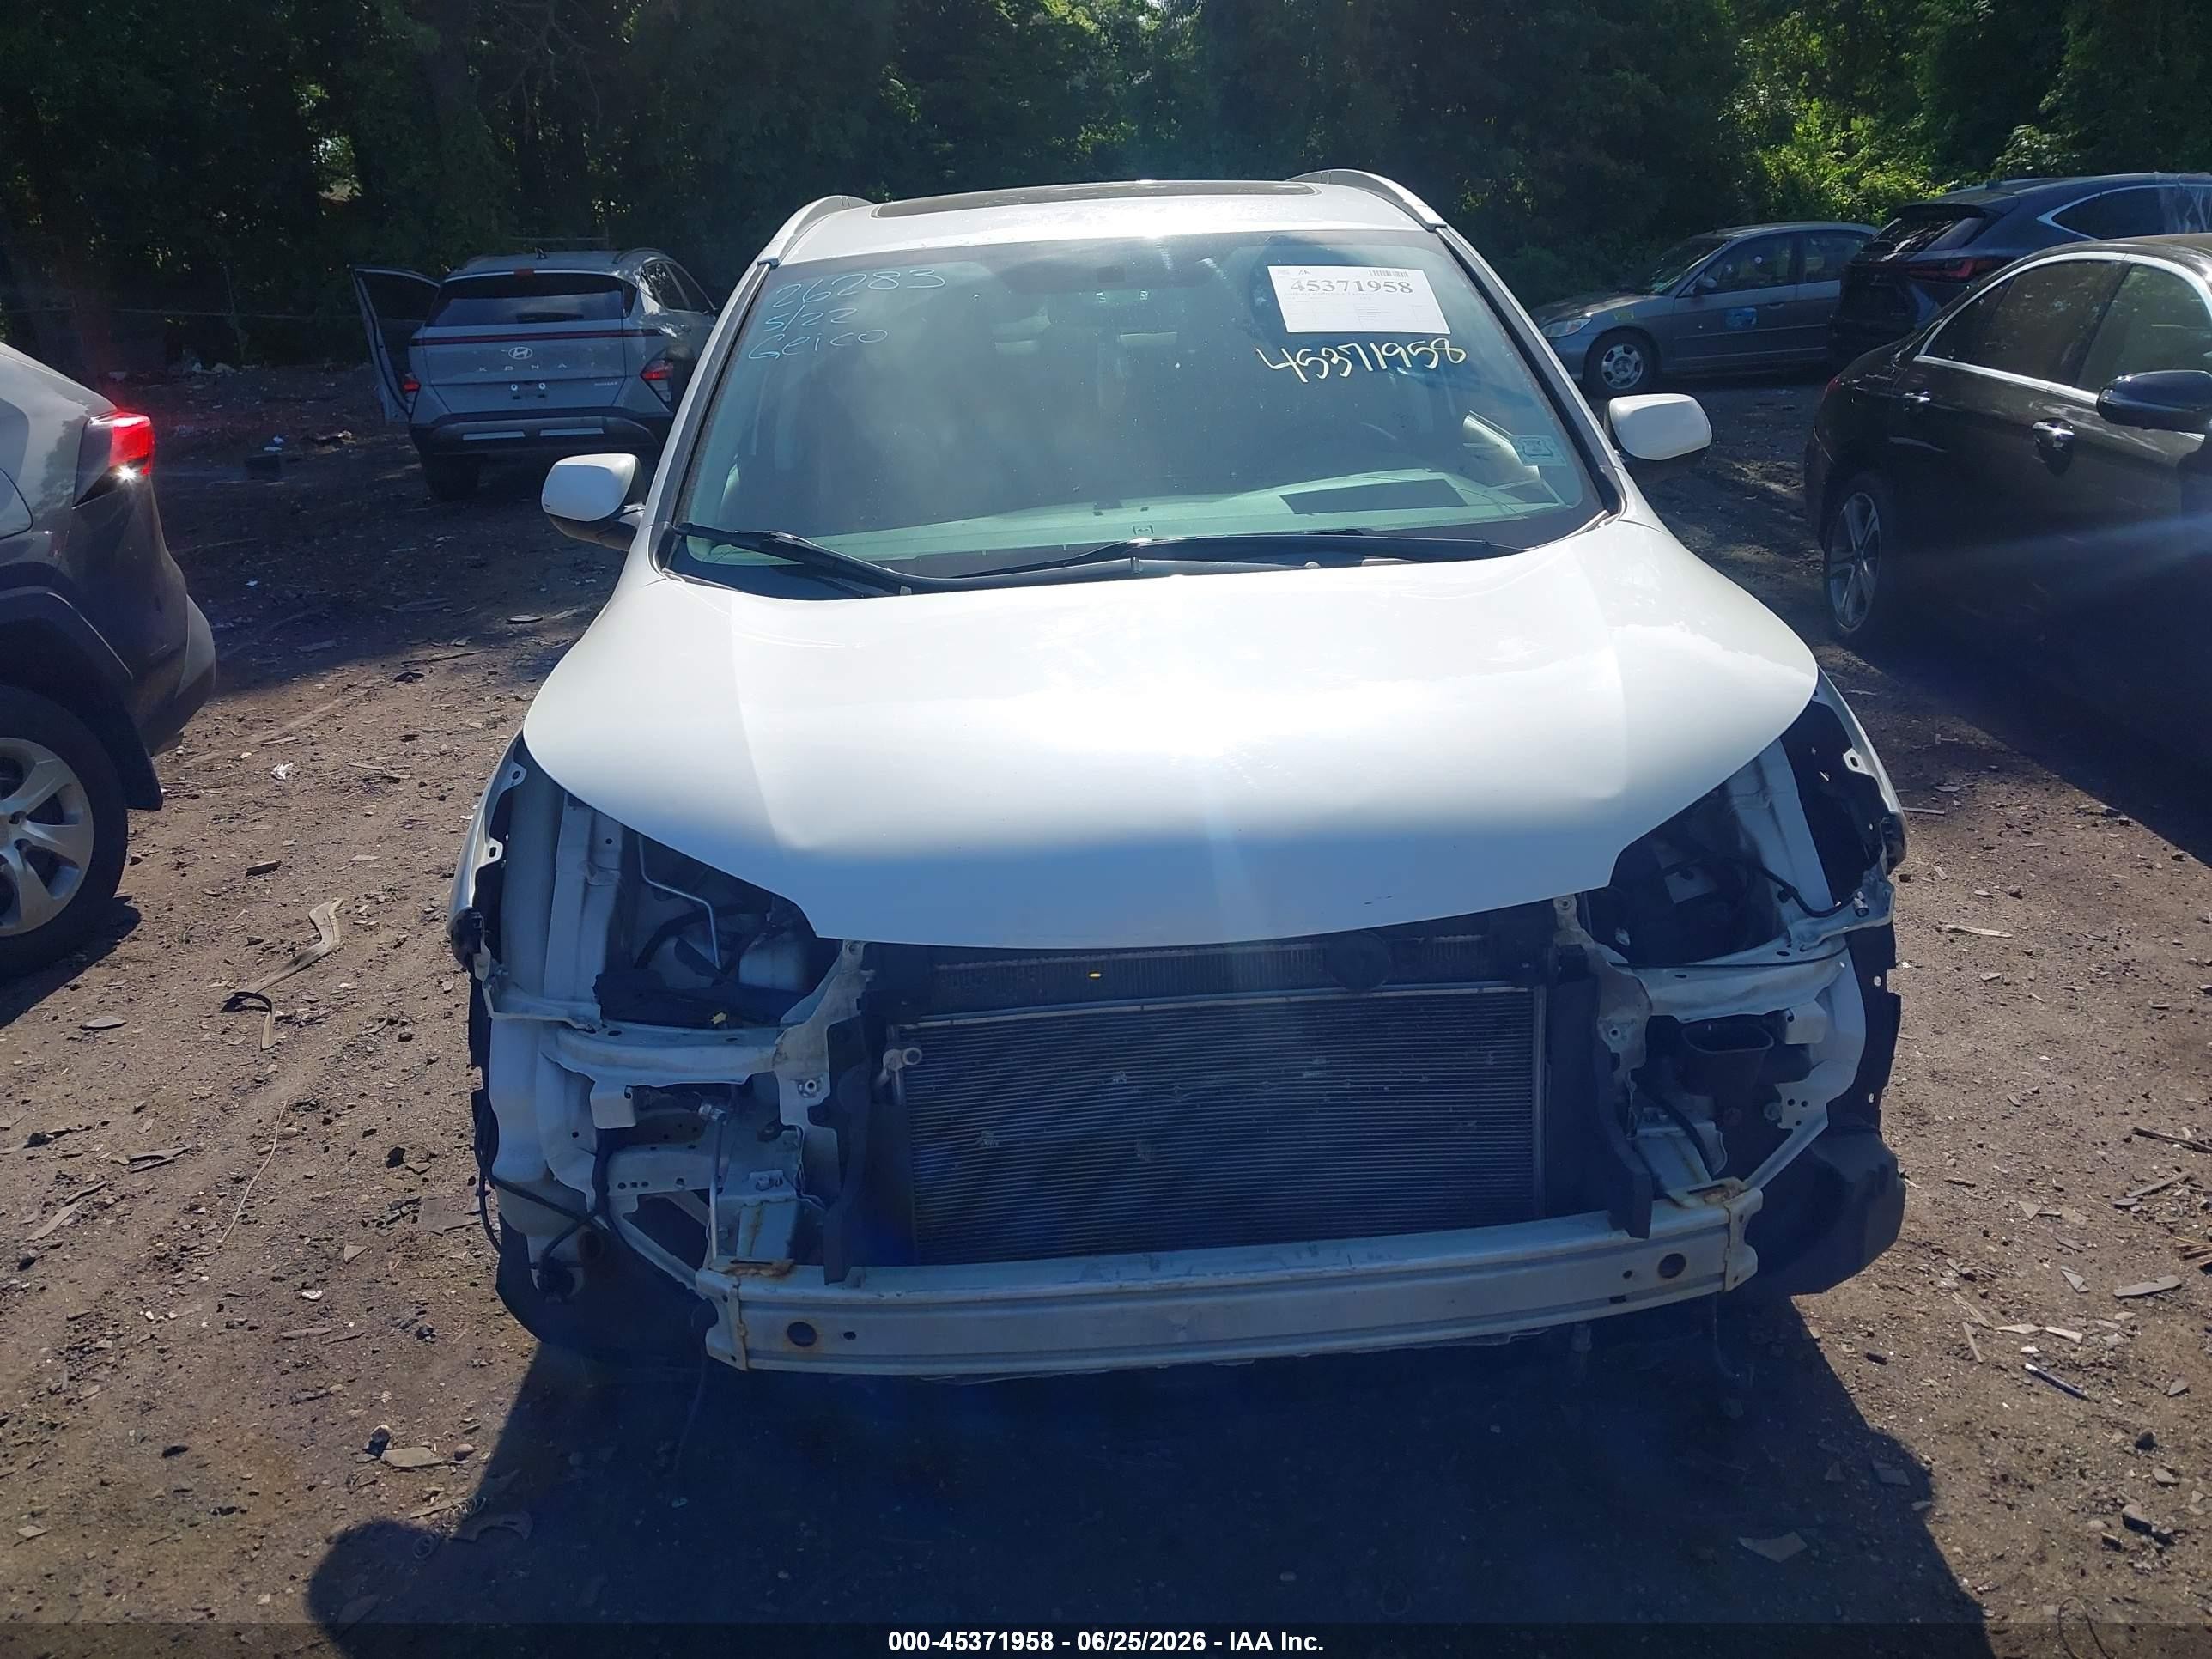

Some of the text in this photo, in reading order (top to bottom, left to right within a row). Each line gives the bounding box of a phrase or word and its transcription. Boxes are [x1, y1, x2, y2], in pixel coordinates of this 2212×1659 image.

[773, 269, 945, 308] 26283
[1291, 279, 1414, 294] 45371958
[763, 304, 858, 332] 5/22
[1254, 337, 1467, 383] 45371958
